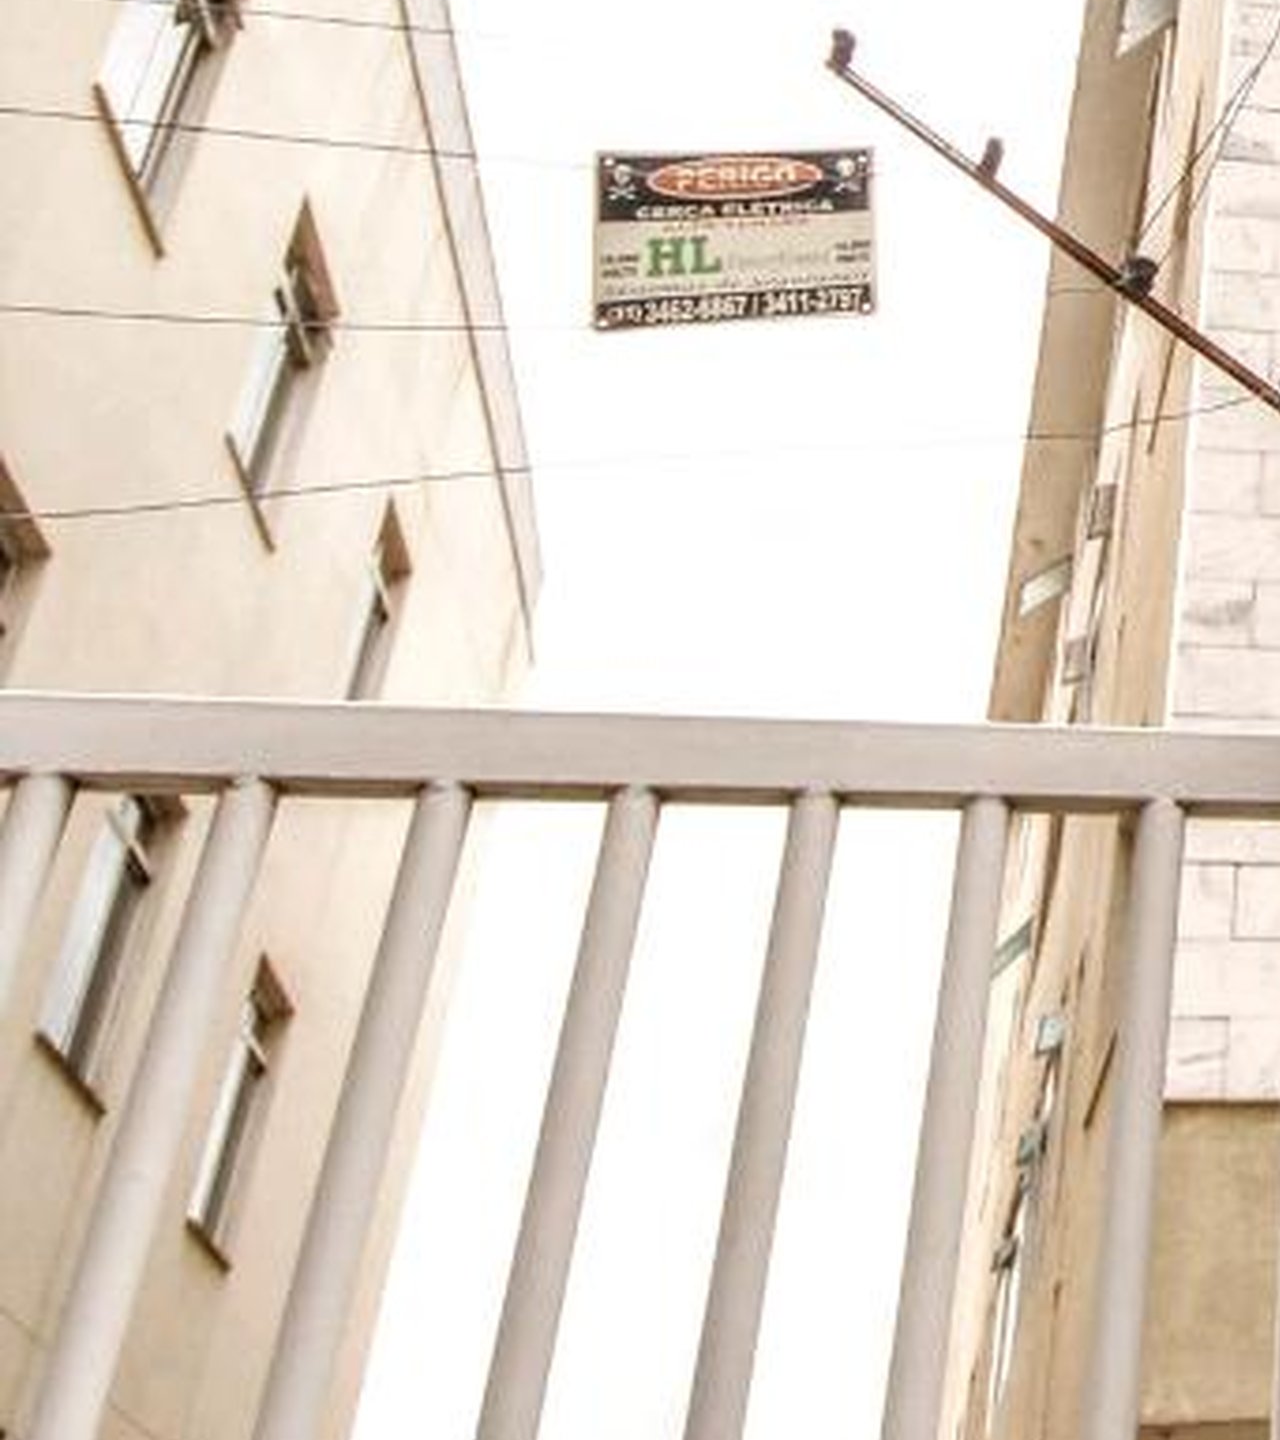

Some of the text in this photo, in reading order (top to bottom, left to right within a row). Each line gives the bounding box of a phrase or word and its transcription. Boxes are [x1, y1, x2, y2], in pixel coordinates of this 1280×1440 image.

[676, 162, 798, 192] PERIGO
[635, 204, 714, 220] CERCA
[646, 235, 722, 278] HL
